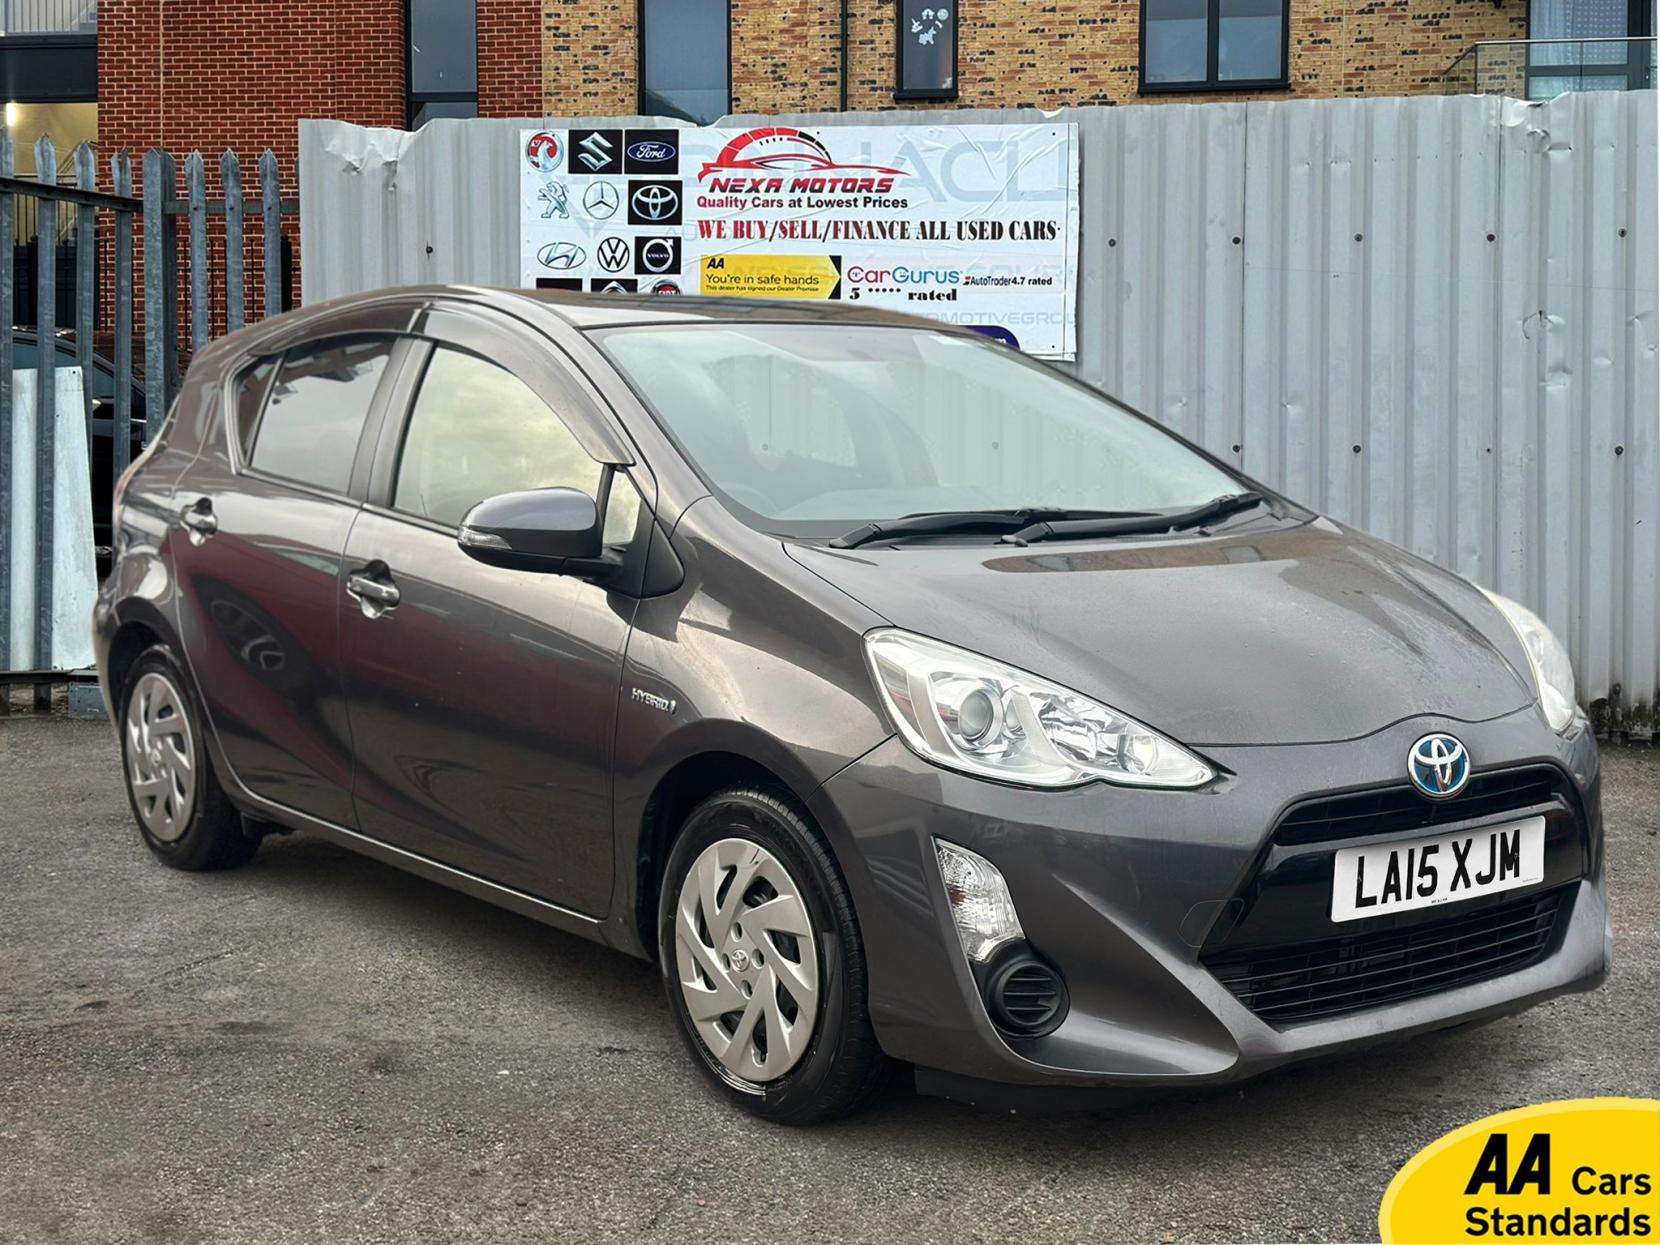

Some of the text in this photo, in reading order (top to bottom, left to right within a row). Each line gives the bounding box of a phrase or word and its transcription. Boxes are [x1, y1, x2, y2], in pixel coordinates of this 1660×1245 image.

[636, 144, 666, 159] Ford
[709, 177, 895, 194] NEXA MOTORS
[697, 196, 908, 211] Quality Cars at Lowest Prices
[697, 220, 728, 240] WE
[733, 219, 911, 242] BUY/SELL/FINANCE
[916, 220, 951, 240] ALL
[956, 220, 1003, 240] USED
[1008, 220, 1057, 241] CARS
[707, 258, 725, 269] AA
[706, 274, 819, 285] You're in safe hands
[847, 266, 960, 284] CarGurus
[1028, 276, 1053, 286] rated
[849, 287, 958, 301] 5 rated
[632, 688, 669, 711] HYBRID
[1355, 829, 1520, 908] LA15 XJM
